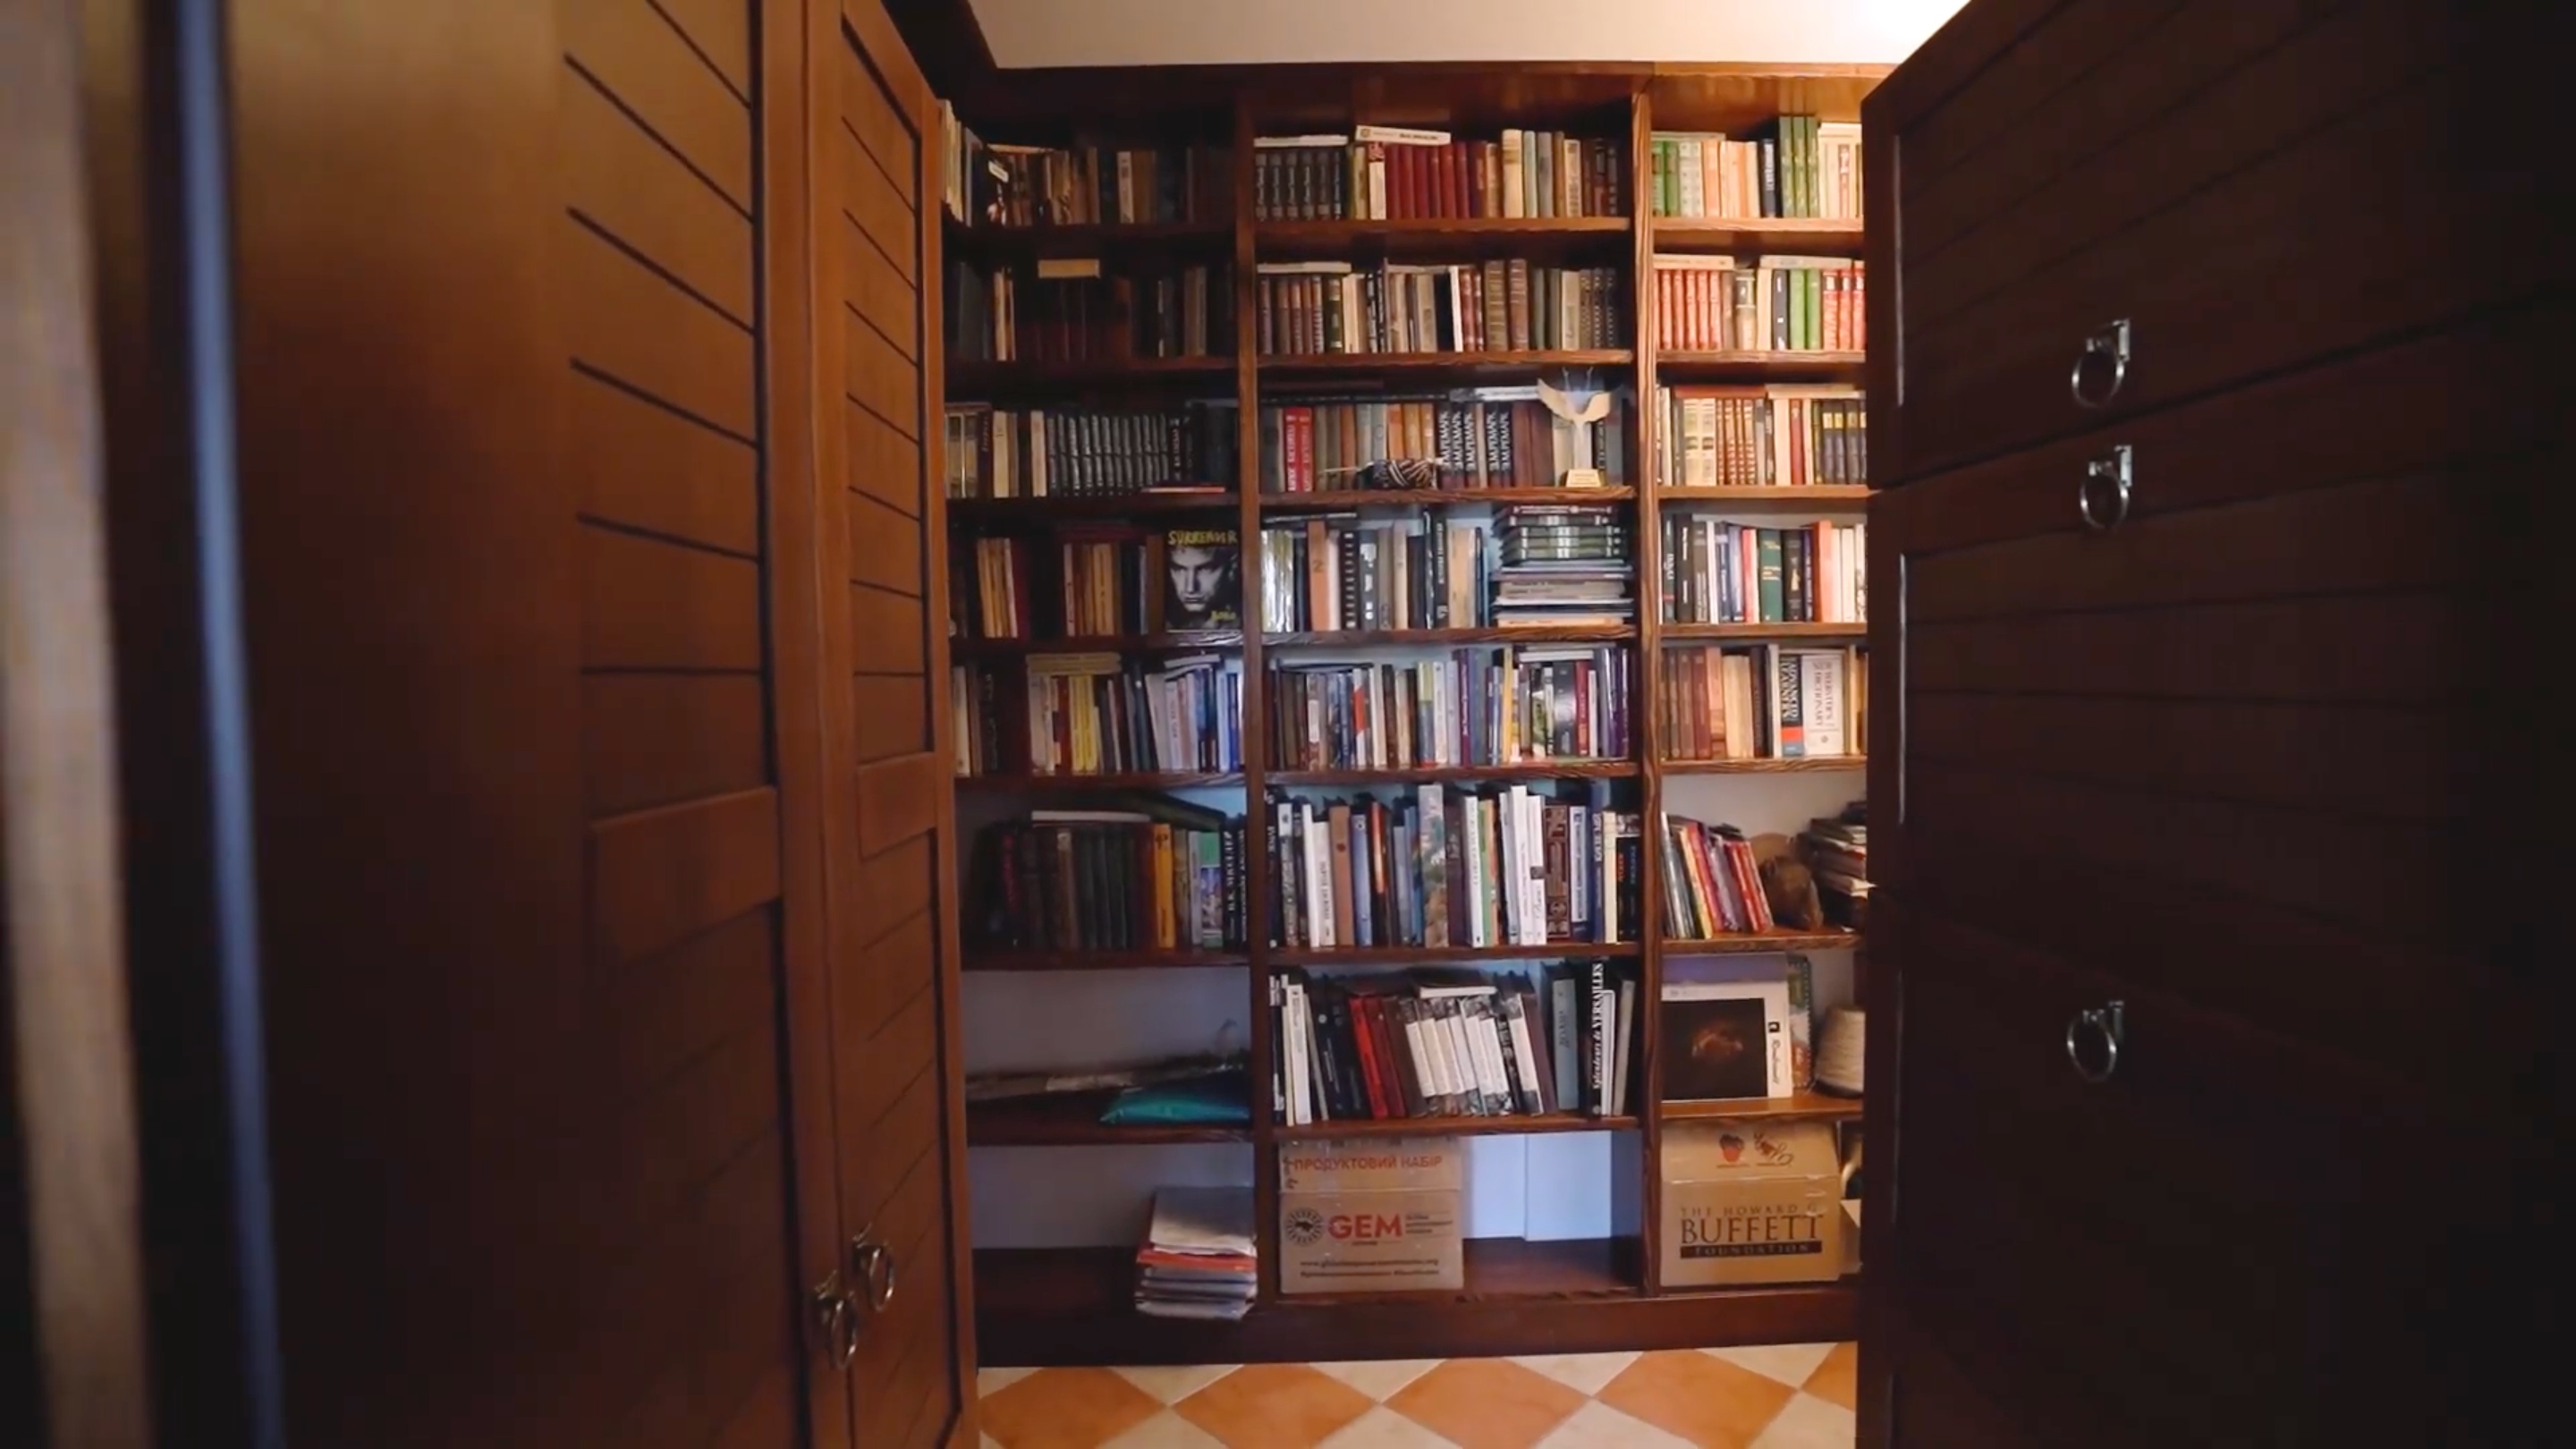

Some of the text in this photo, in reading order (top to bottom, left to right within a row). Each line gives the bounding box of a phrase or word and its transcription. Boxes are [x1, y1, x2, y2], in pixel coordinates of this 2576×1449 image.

[1167, 530, 1238, 546] SURRENDER
[1592, 962, 1604, 1030] VERSAILLES
[1294, 1155, 1443, 1171] ПРОДУКТОВИЙ НАБІР
[1681, 1207, 1712, 1217] THE
[1724, 1204, 1798, 1216] HOWARD
[1327, 1213, 1402, 1239] GEM
[1681, 1215, 1824, 1244] BUFFETT
[1694, 1244, 1809, 1256] FOUNDATION
